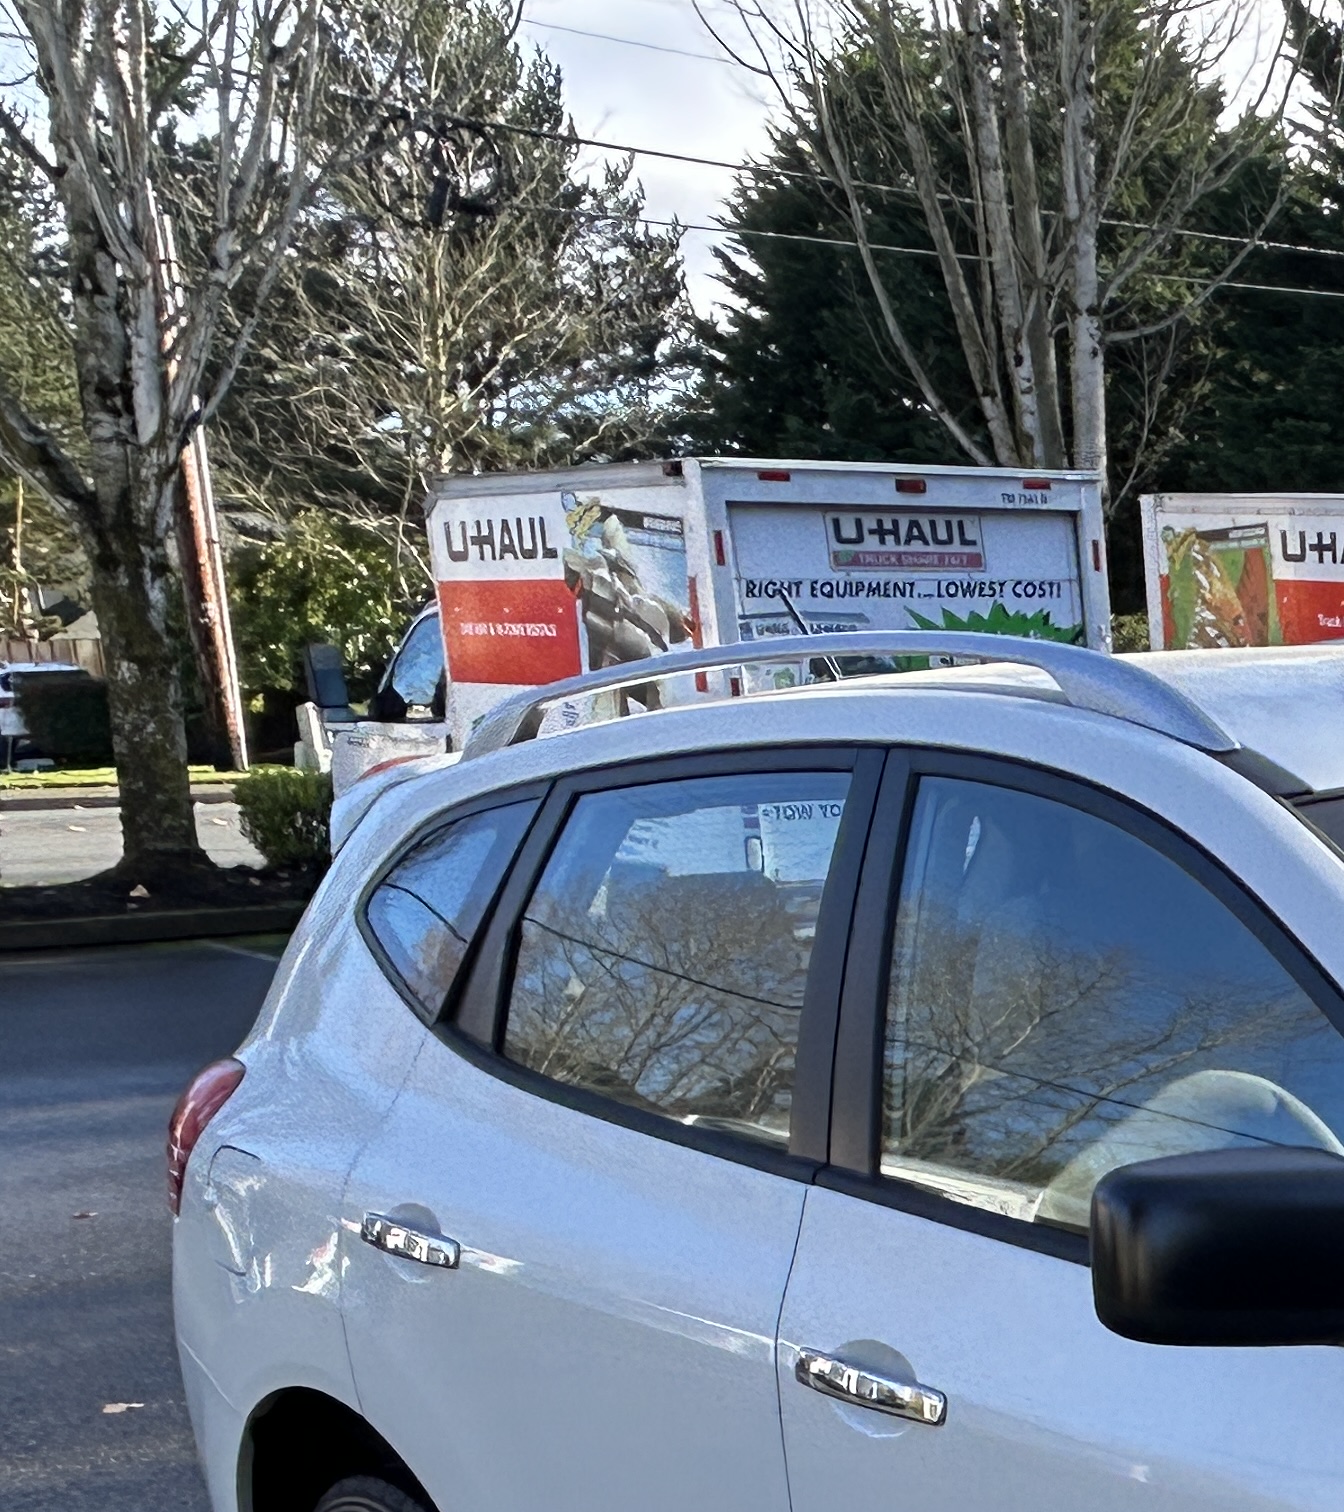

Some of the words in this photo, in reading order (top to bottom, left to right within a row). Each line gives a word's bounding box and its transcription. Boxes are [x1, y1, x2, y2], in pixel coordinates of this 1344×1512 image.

[443, 515, 558, 562] U-HAUL
[831, 517, 978, 547] U-HAUL
[745, 579, 803, 599] RIGHT
